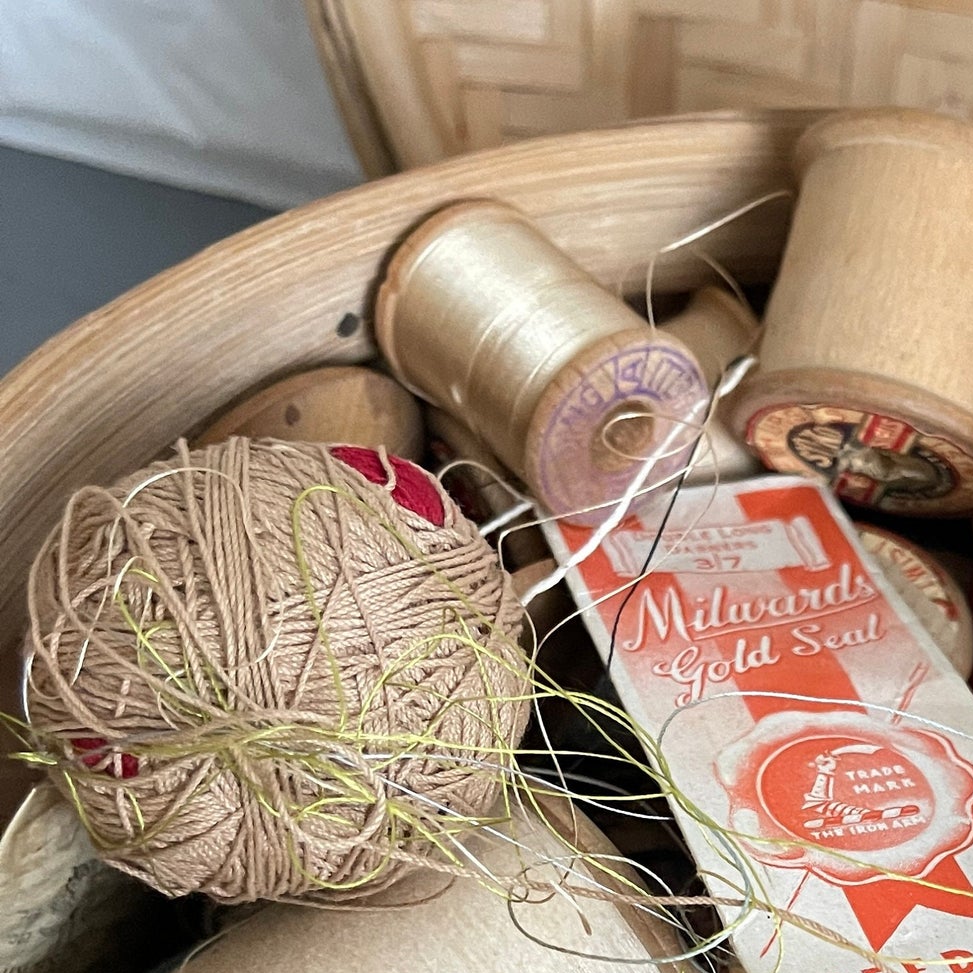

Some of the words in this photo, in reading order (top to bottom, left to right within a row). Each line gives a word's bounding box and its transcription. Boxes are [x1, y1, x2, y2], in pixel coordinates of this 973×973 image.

[622, 563, 878, 652] Milwards
[653, 635, 780, 708] Gold
[789, 613, 889, 658] Seal
[845, 764, 906, 782] TRADE
[852, 777, 916, 796] MARK
[809, 825, 845, 840] THE
[849, 821, 889, 836] IRON
[892, 815, 928, 831] ARM
